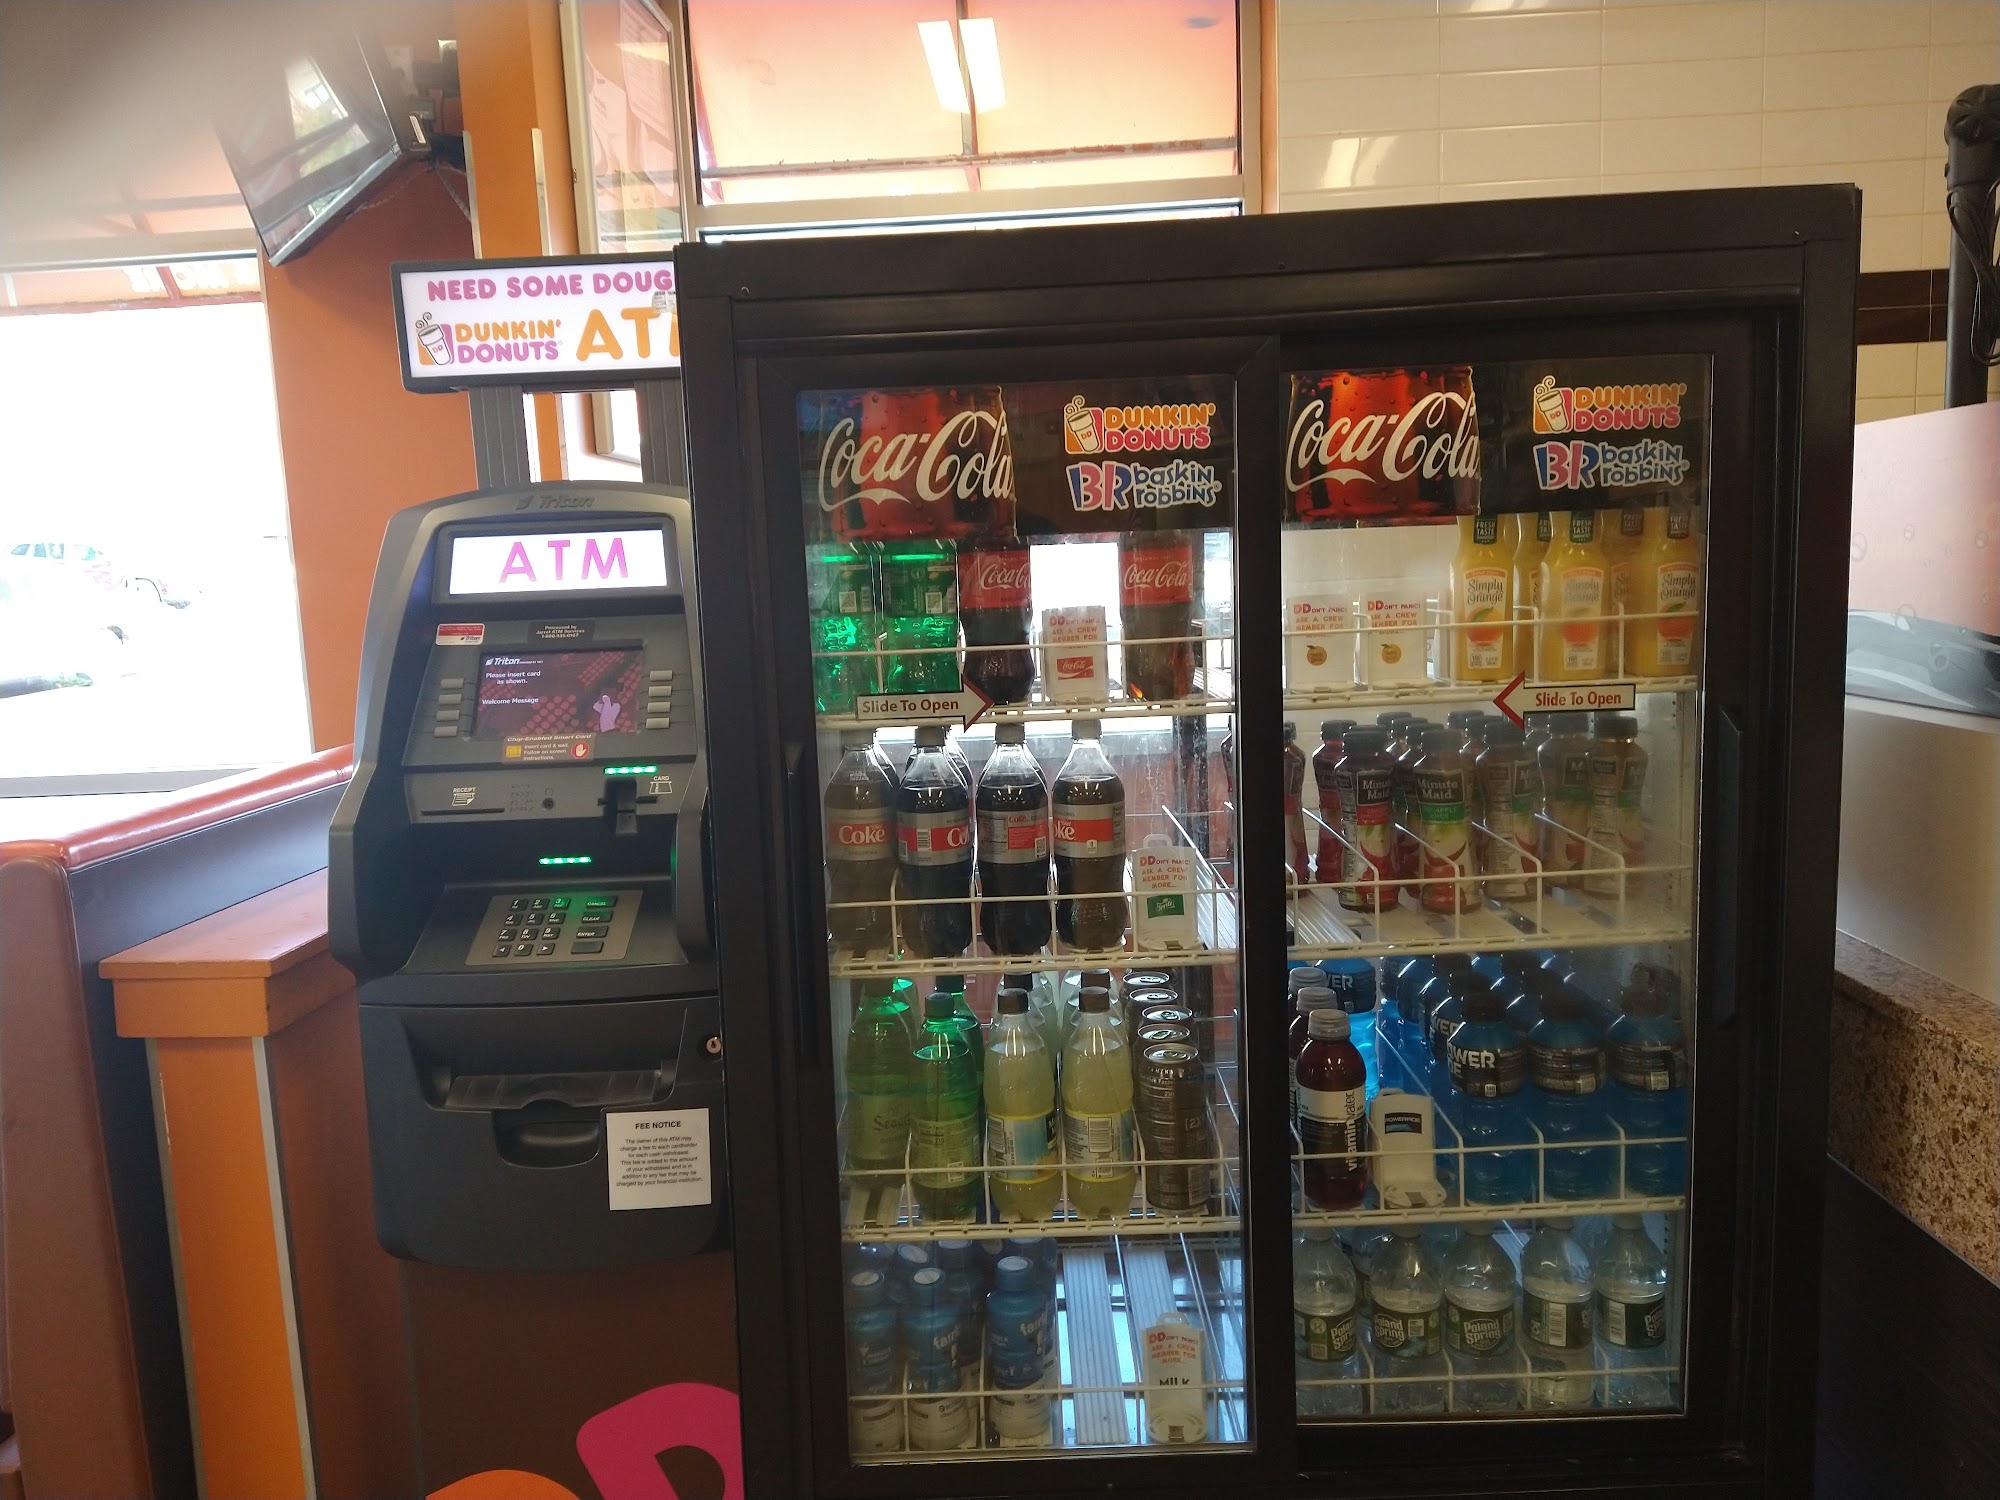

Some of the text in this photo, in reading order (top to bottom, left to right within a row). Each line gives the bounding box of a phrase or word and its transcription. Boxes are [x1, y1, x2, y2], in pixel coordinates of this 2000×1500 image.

[427, 278, 497, 301] NEED
[506, 274, 583, 298] SOME
[455, 319, 561, 343] DUNKIN'
[458, 340, 559, 364] DONUTS
[1574, 383, 1687, 408] DUNKIN'
[1105, 403, 1216, 428] DUNKIN'
[1574, 407, 1681, 432] DONUTS
[1105, 427, 1211, 453] DONUTS
[1285, 391, 1480, 492] Coca-Cola
[818, 410, 1014, 512] Coca-Cola
[1601, 439, 1684, 466] baskin
[1133, 459, 1214, 486] baskin
[1602, 462, 1685, 488] robbins
[539, 494, 595, 510] Triton
[1134, 483, 1217, 508] robbins
[499, 537, 629, 583] ATM
[1124, 561, 1189, 589] Coca-Cola
[1468, 579, 1503, 593] Simply
[1661, 573, 1696, 588] Simply
[1467, 591, 1503, 605] Orange
[1660, 587, 1696, 600] Orange
[494, 657, 520, 665] Triton
[862, 699, 959, 713] Slide To Open
[1535, 691, 1622, 708] Slide To Open
[1418, 778, 1458, 789] Minute
[839, 825, 886, 844] Coke
[652, 1121, 682, 1129] NOTICE
[1344, 1091, 1358, 1172] viaminwater
[1374, 1314, 1403, 1331] Poland
[1374, 1326, 1405, 1341] Spring
[1463, 1319, 1500, 1335] Poland
[1465, 1329, 1501, 1345] Spring
